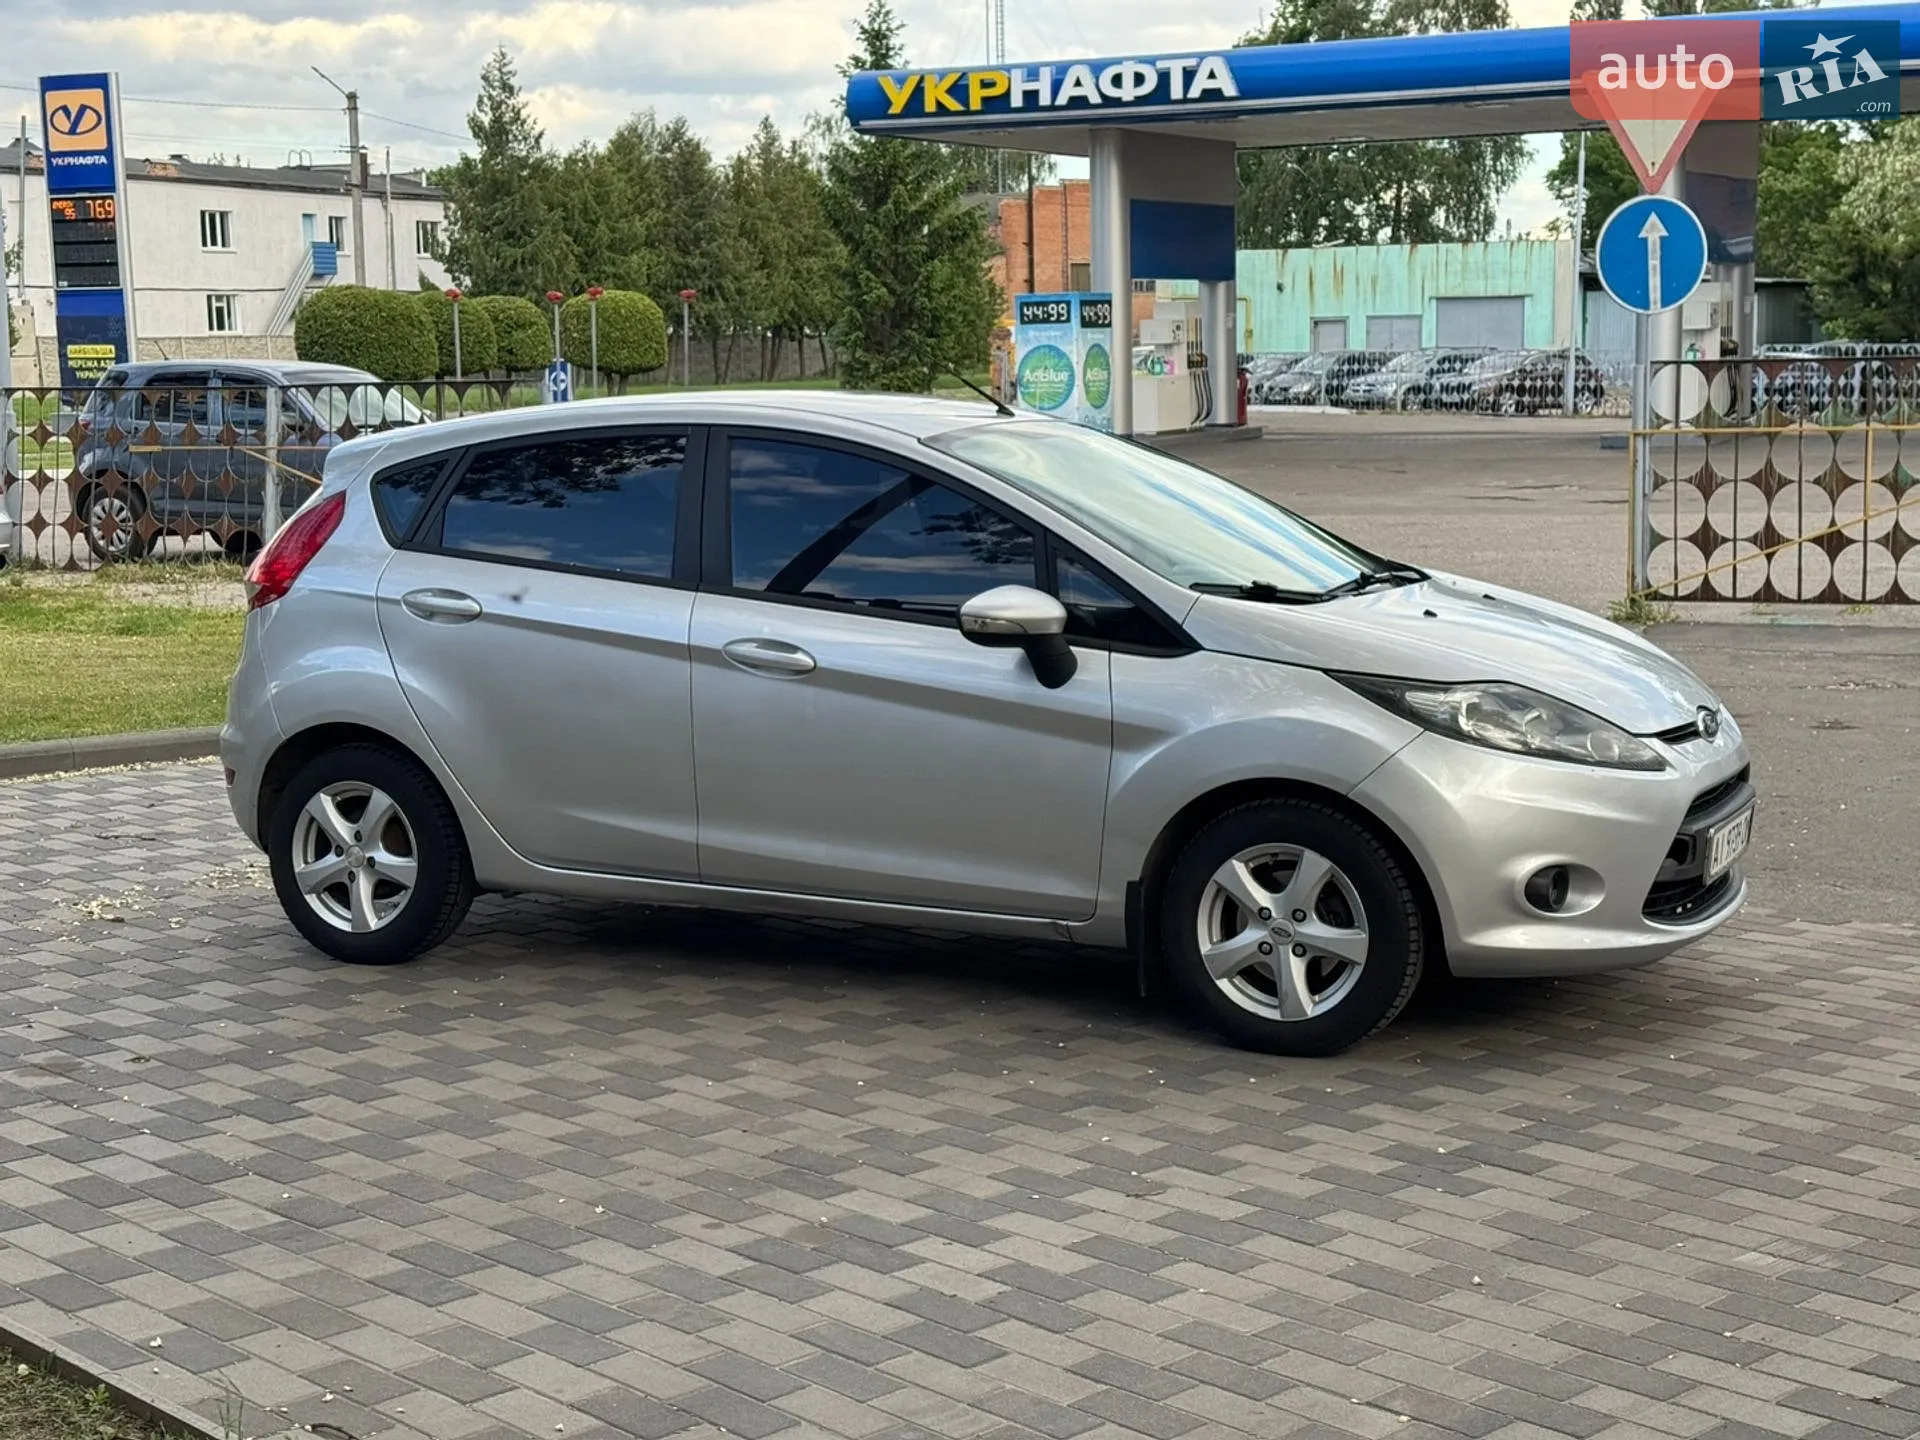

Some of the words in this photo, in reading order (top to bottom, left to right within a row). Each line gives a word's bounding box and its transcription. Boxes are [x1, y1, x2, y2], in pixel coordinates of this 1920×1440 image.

[877, 56, 1240, 115] УКРНАФТА
[51, 154, 108, 167] УКРНАФТА
[1023, 367, 1069, 383] AdBlue
